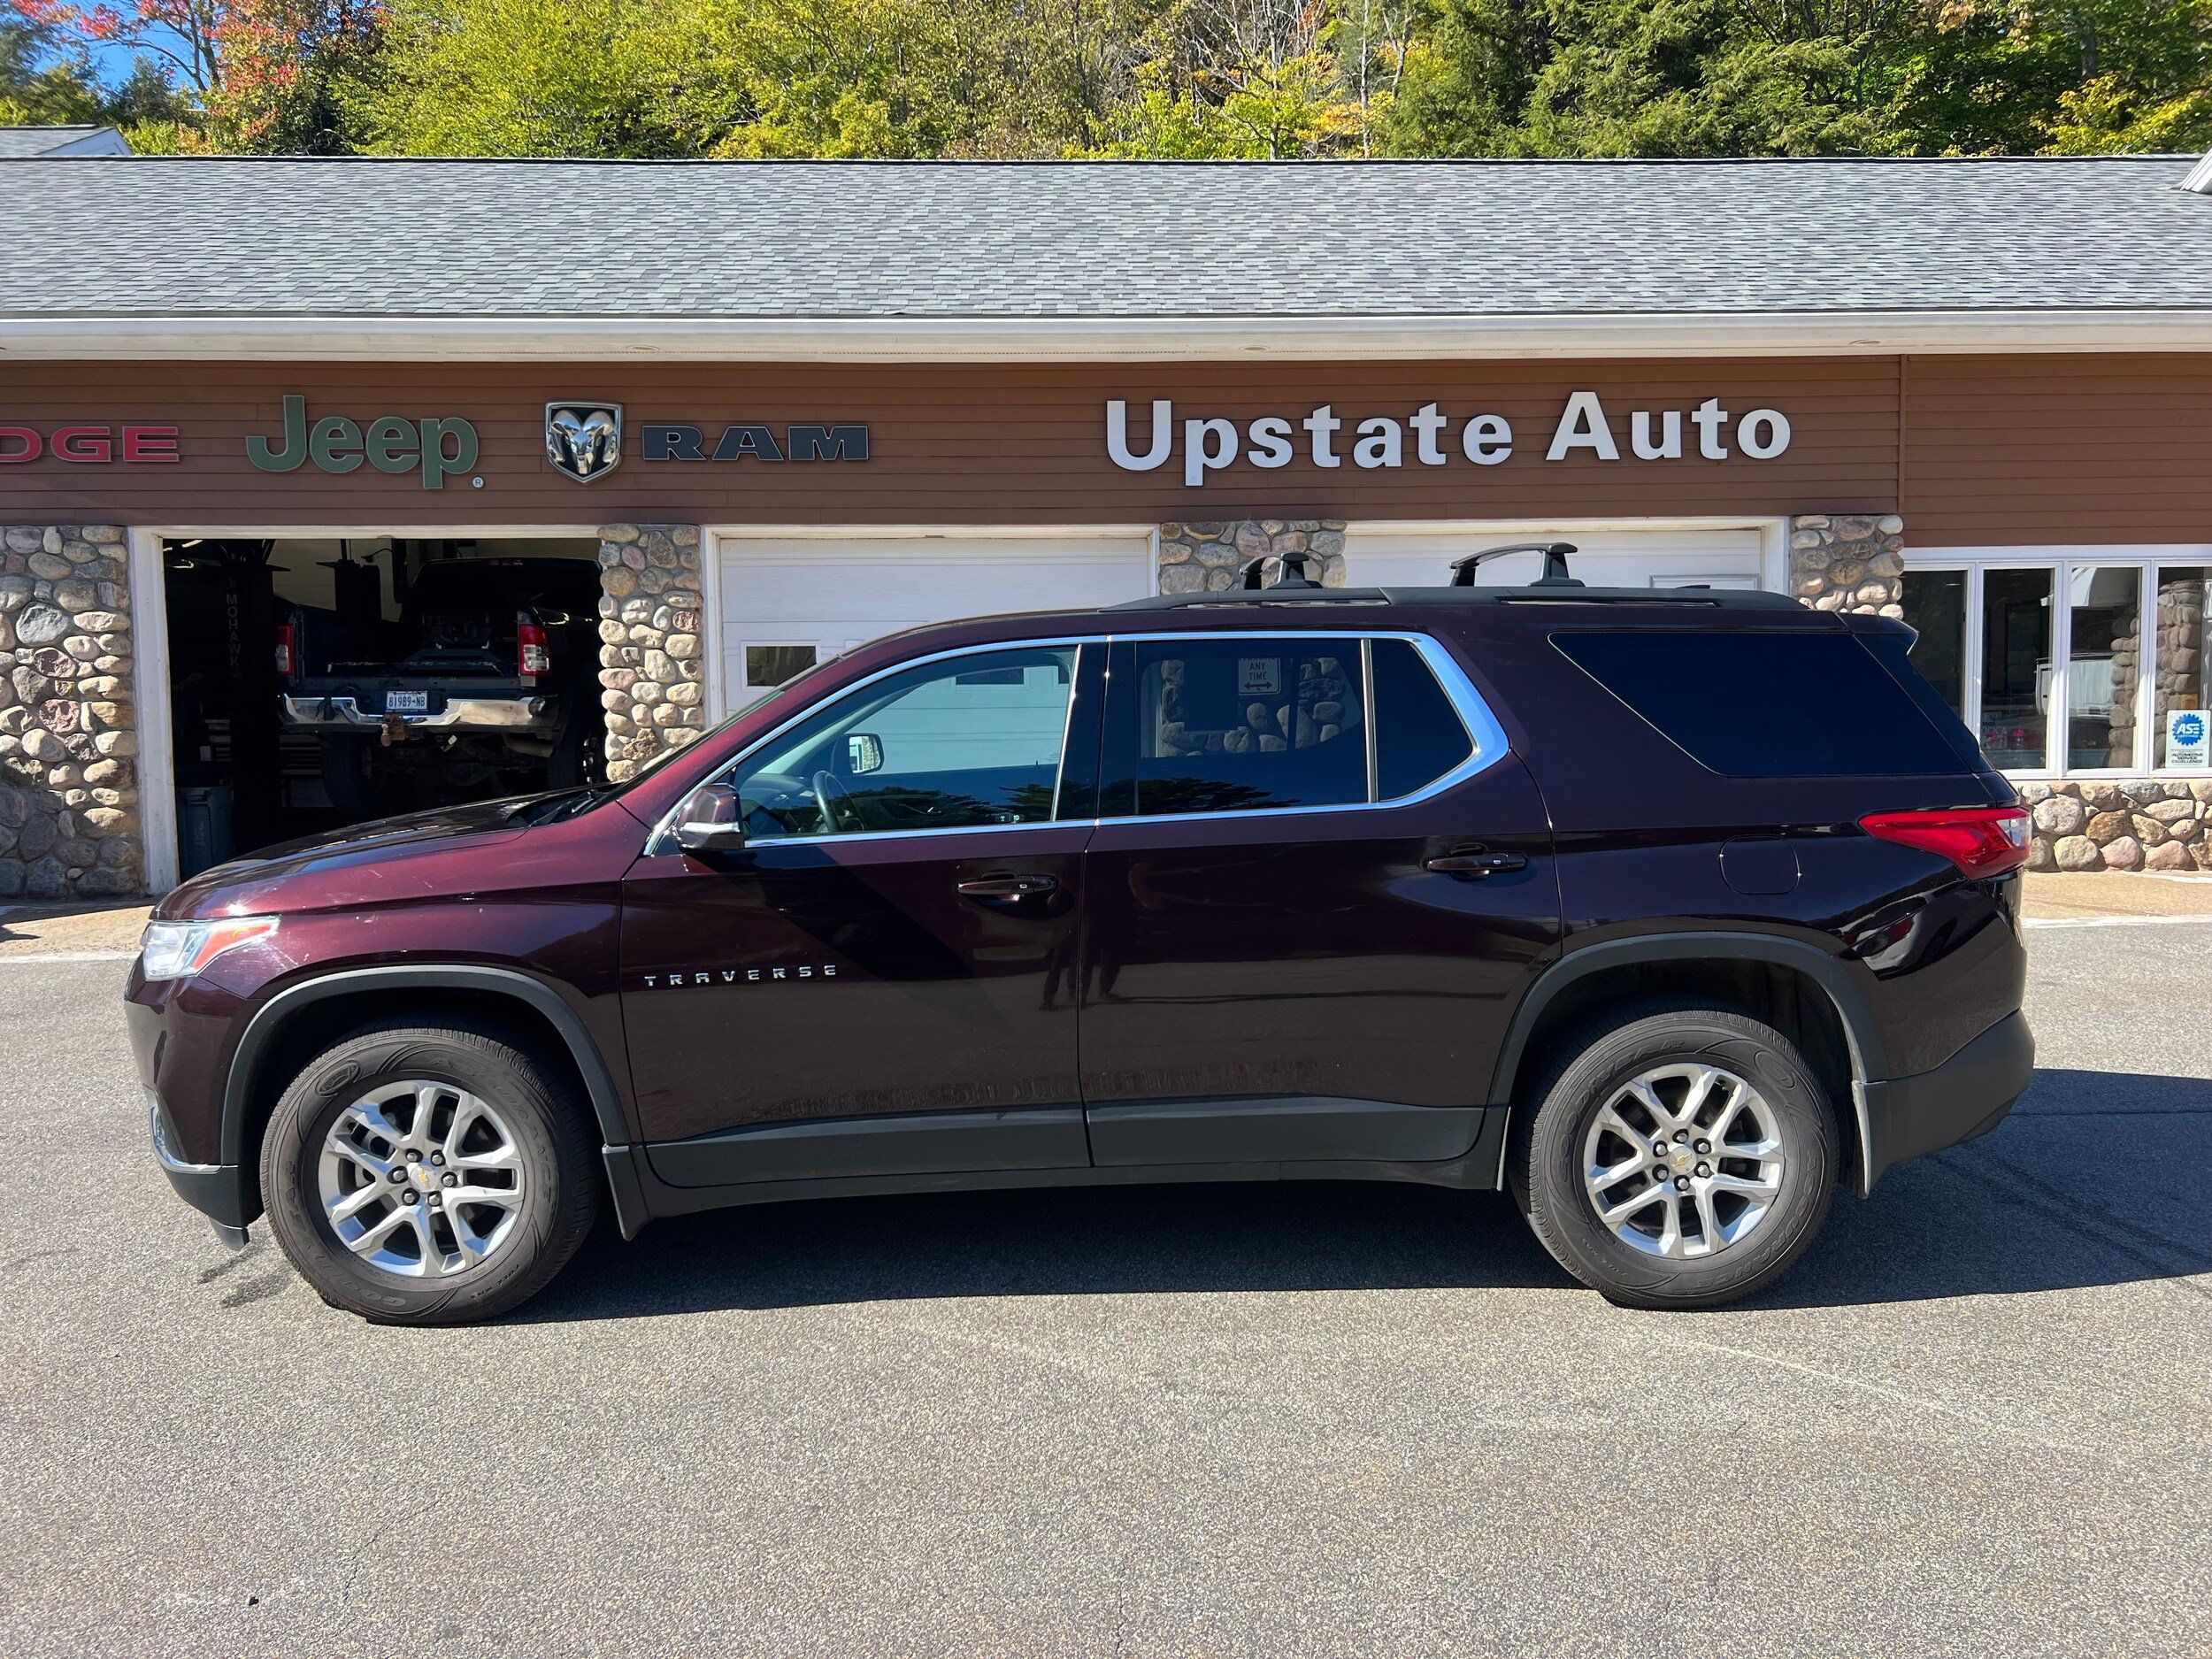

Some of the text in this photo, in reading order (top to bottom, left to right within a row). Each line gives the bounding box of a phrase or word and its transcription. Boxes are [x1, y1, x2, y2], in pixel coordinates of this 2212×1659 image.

[246, 395, 480, 488] Jeep
[641, 425, 869, 461] RAM
[1106, 390, 1792, 487] Upstate Auto
[227, 594, 241, 667] MOHAWK
[2177, 723, 2200, 734] ASE
[644, 964, 836, 987] TRAVERSE
